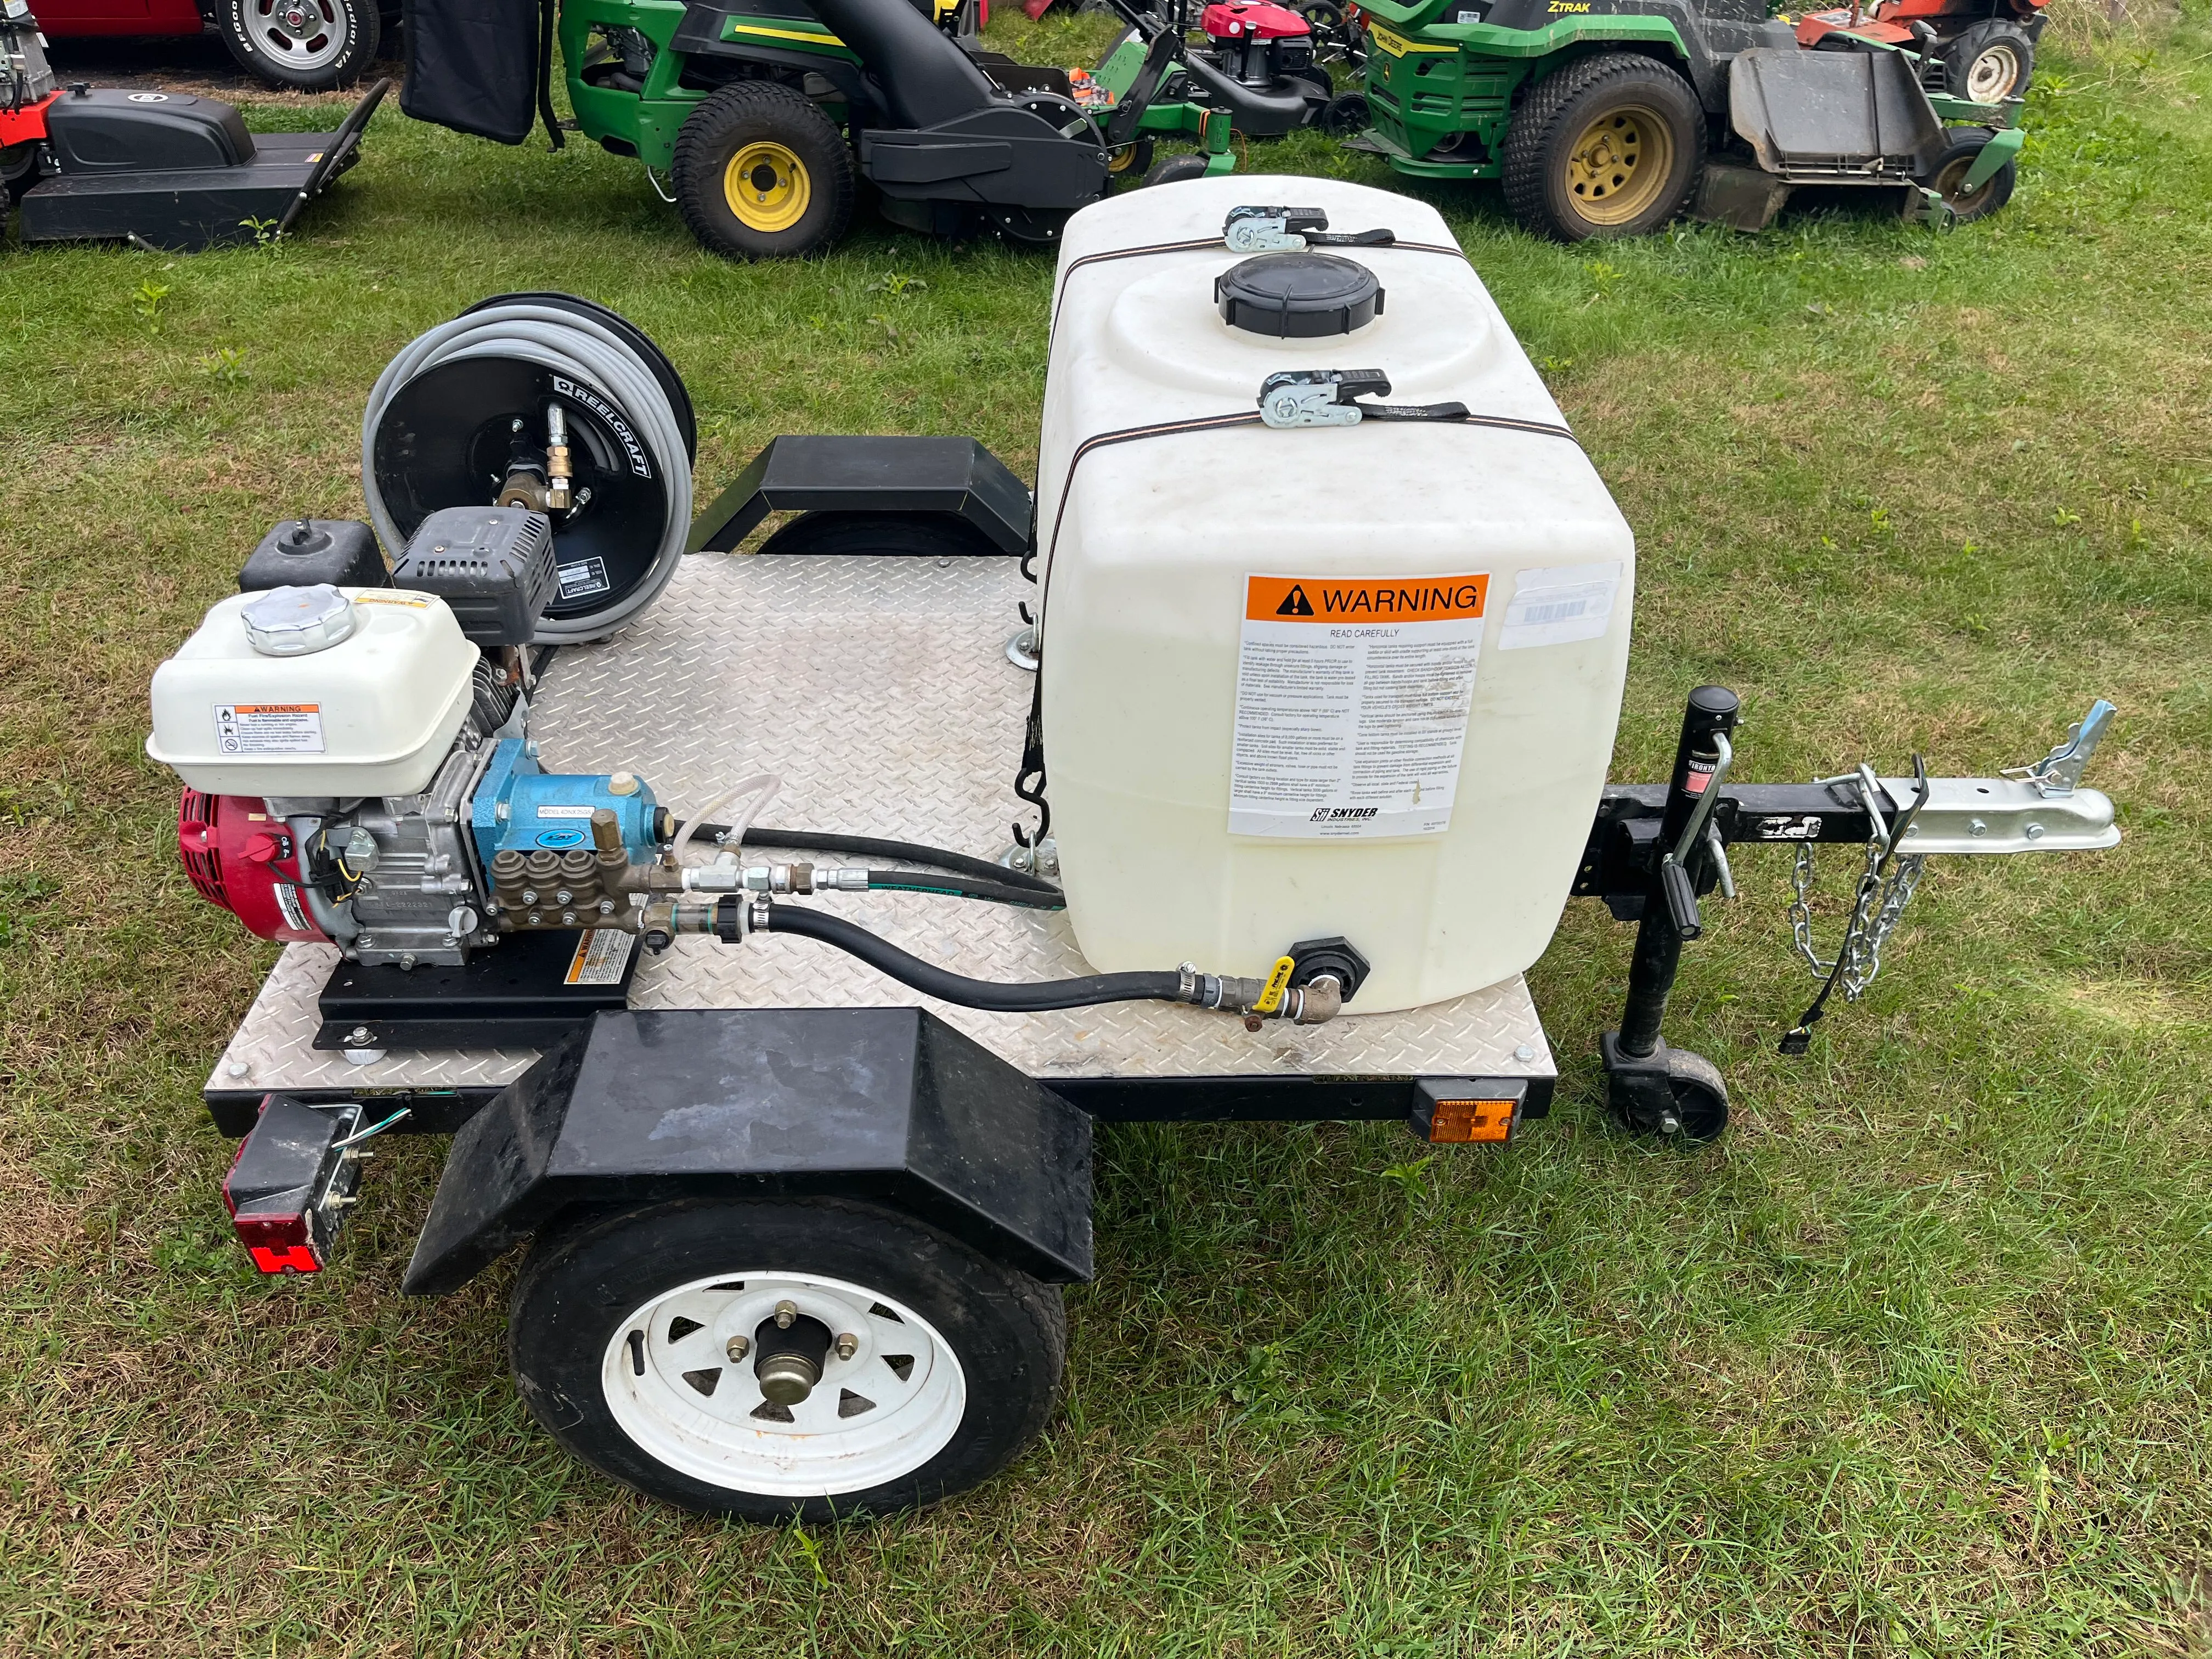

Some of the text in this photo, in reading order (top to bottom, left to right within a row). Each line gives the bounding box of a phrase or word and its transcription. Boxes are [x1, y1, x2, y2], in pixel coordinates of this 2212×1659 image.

[1547, 1, 1591, 13] ZTRAK
[575, 387, 648, 476] REELCRAFT
[567, 583, 596, 594] REELCRAFT
[1323, 585, 1477, 613] WARNING
[1330, 629, 1400, 637] READ CAREFULLY
[1691, 763, 1717, 772] IRONTO
[1330, 808, 1379, 817] SNYDER
